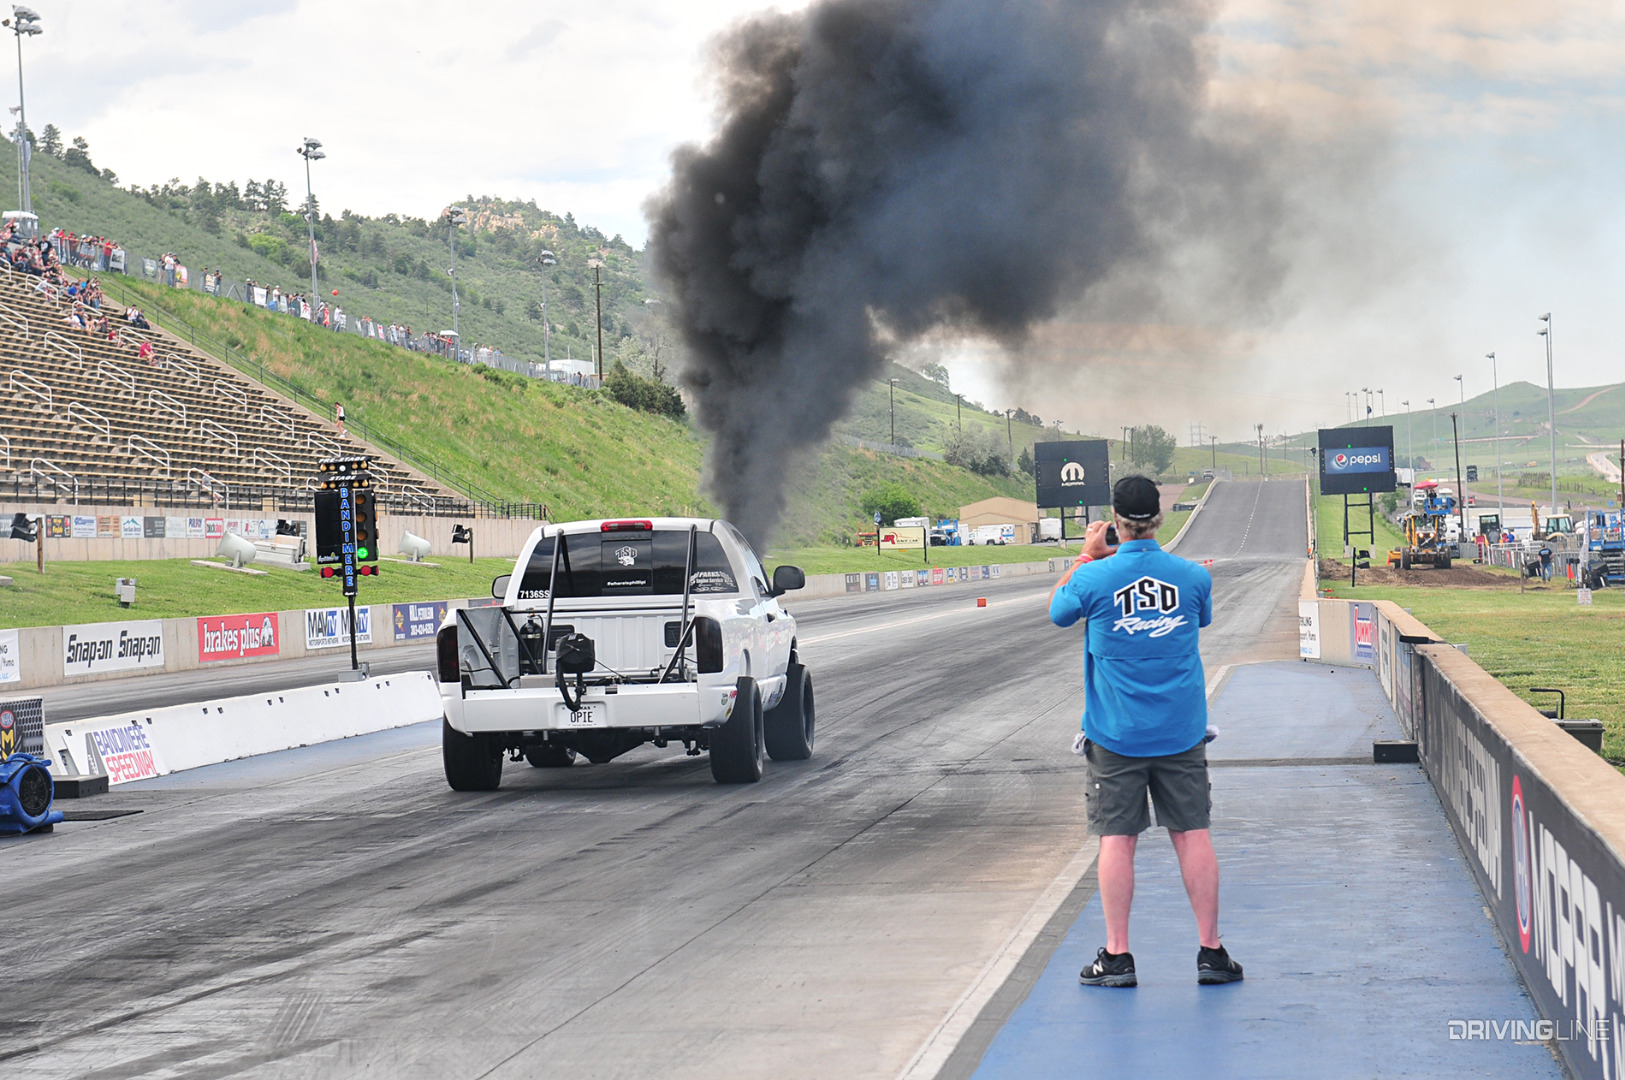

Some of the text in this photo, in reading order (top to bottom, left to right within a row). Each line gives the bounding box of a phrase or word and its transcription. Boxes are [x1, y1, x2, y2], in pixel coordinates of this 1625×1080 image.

[318, 456, 366, 464] PRE-STAGE
[1350, 453, 1381, 466] pepsi
[340, 488, 354, 587] BANDIMERE
[520, 590, 550, 598] 7136SS
[1114, 576, 1179, 617] TSD
[341, 608, 368, 635] MVTV
[1112, 615, 1188, 638] Racing
[66, 630, 160, 668] Snap-on Snap-on
[203, 619, 260, 656] brakes plus
[570, 711, 593, 723] OPIE
[93, 725, 150, 756] BANDIMERE
[105, 750, 157, 782] SPEEDWAY
[1529, 810, 1611, 1080] MOPAR
